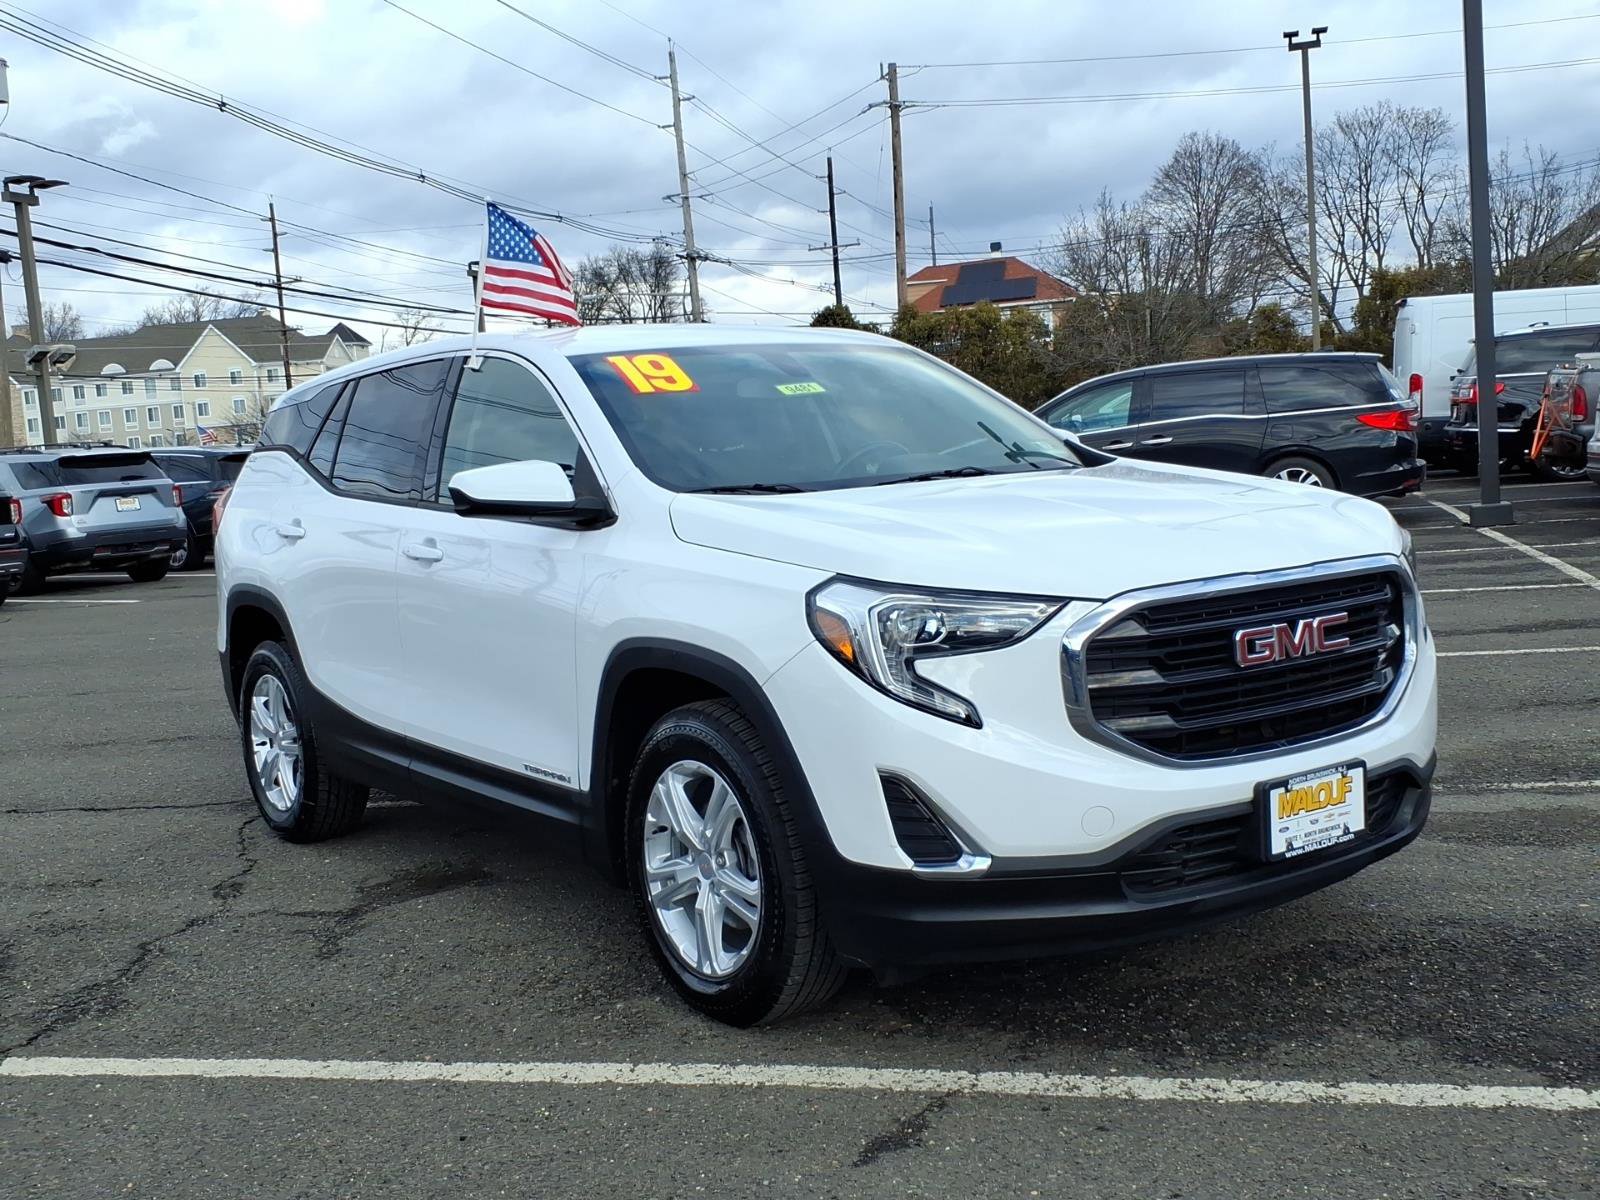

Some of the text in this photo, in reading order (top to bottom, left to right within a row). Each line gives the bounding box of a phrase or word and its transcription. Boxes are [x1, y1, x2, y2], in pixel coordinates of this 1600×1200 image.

[606, 354, 693, 393] 19
[1235, 612, 1350, 667] GMC
[1278, 776, 1353, 820] MALOUF
